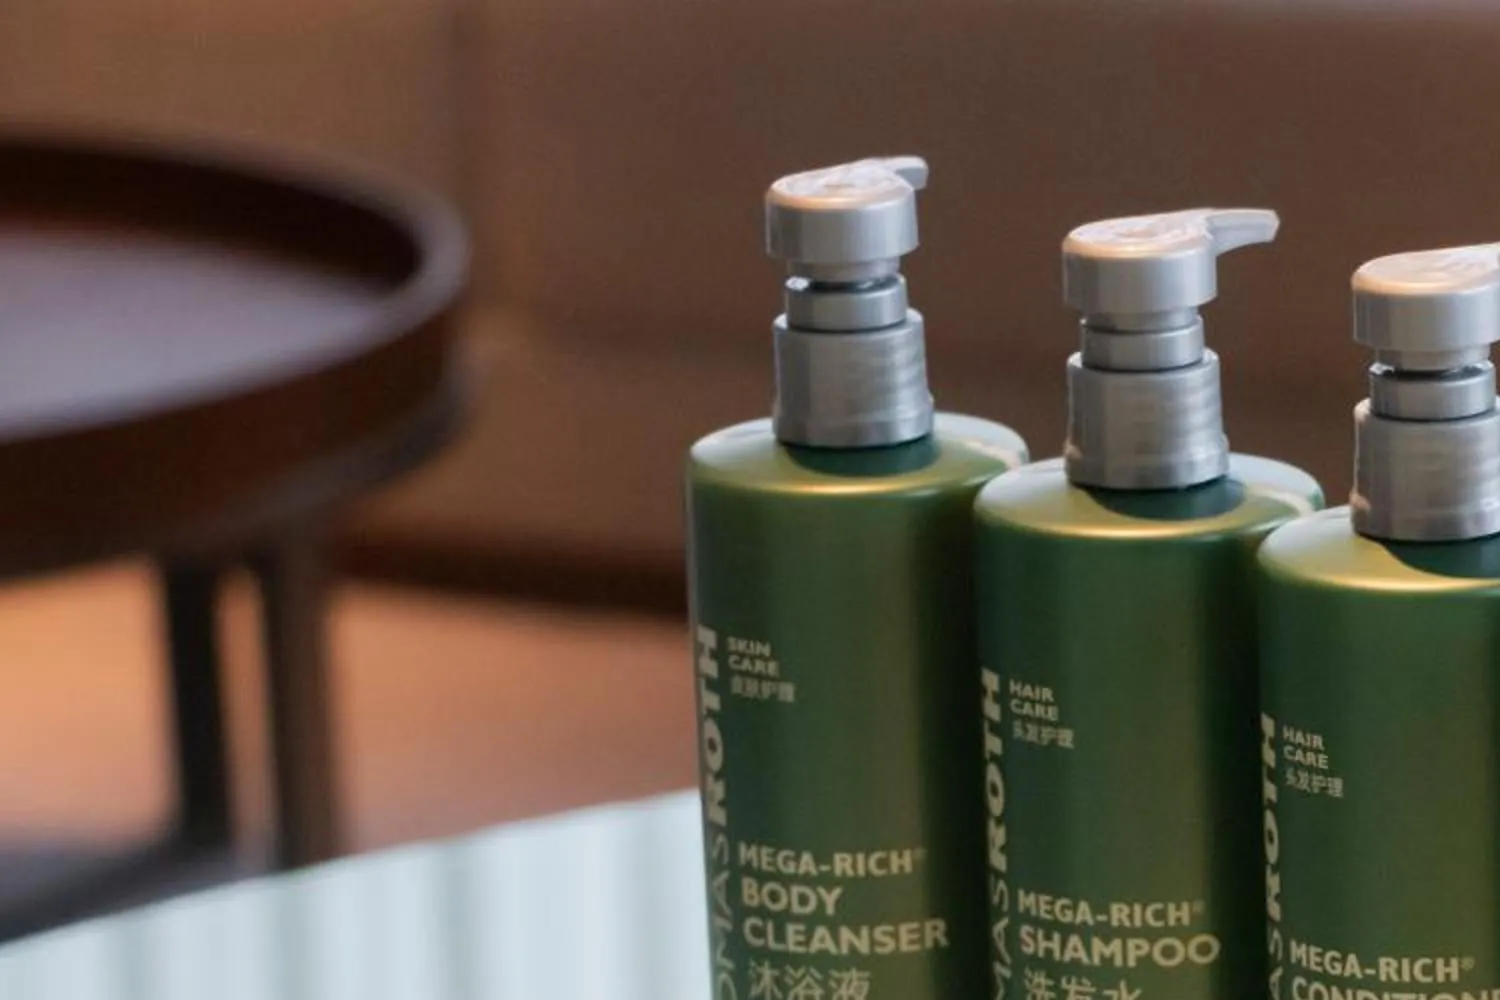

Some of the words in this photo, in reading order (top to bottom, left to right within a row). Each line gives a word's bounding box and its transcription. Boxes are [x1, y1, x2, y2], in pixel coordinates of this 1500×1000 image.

[728, 636, 771, 657] SKIN
[728, 655, 779, 677] CARE
[1010, 679, 1054, 702] HAIR
[1010, 699, 1059, 721] CARE
[1283, 726, 1324, 750] HAIR
[1284, 746, 1328, 769] CARE
[742, 878, 842, 916] BODY
[743, 917, 948, 955] CLEANSER
[1019, 925, 1220, 968] SHAMPOO
